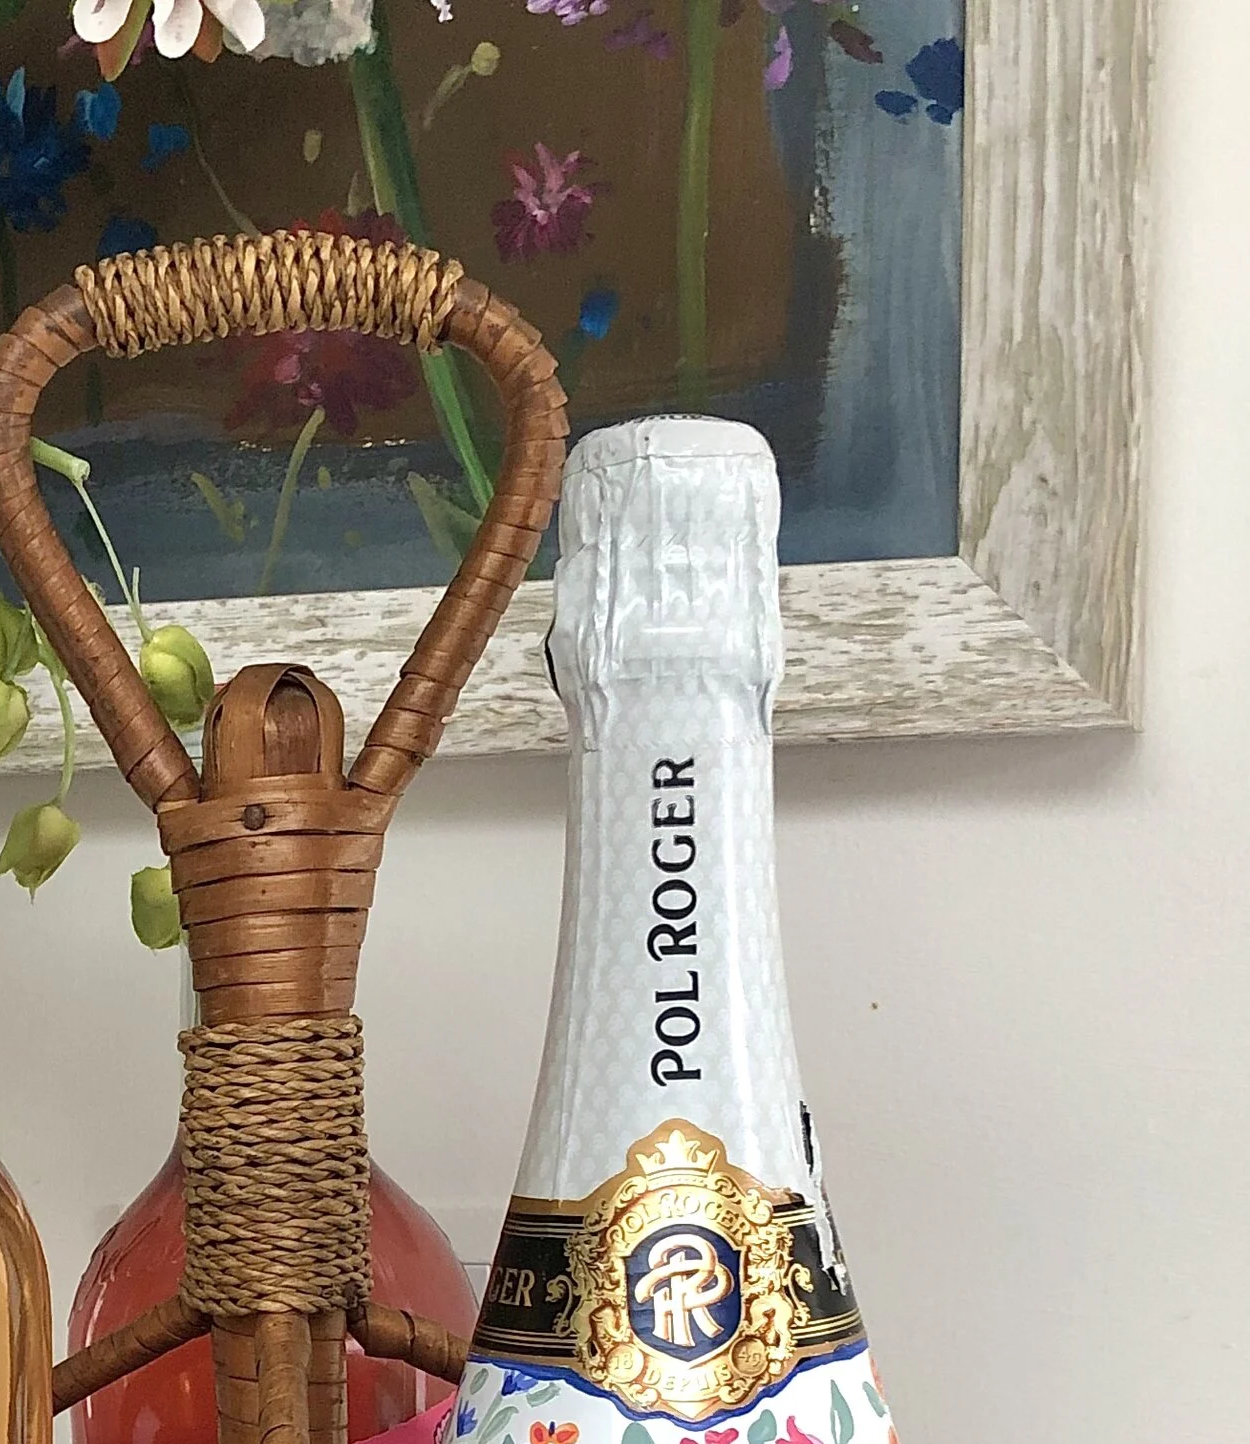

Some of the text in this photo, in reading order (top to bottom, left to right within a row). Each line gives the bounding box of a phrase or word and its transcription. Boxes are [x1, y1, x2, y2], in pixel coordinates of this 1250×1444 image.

[646, 754, 701, 1087] POL ROGER
[659, 1189, 751, 1241] ROGER
